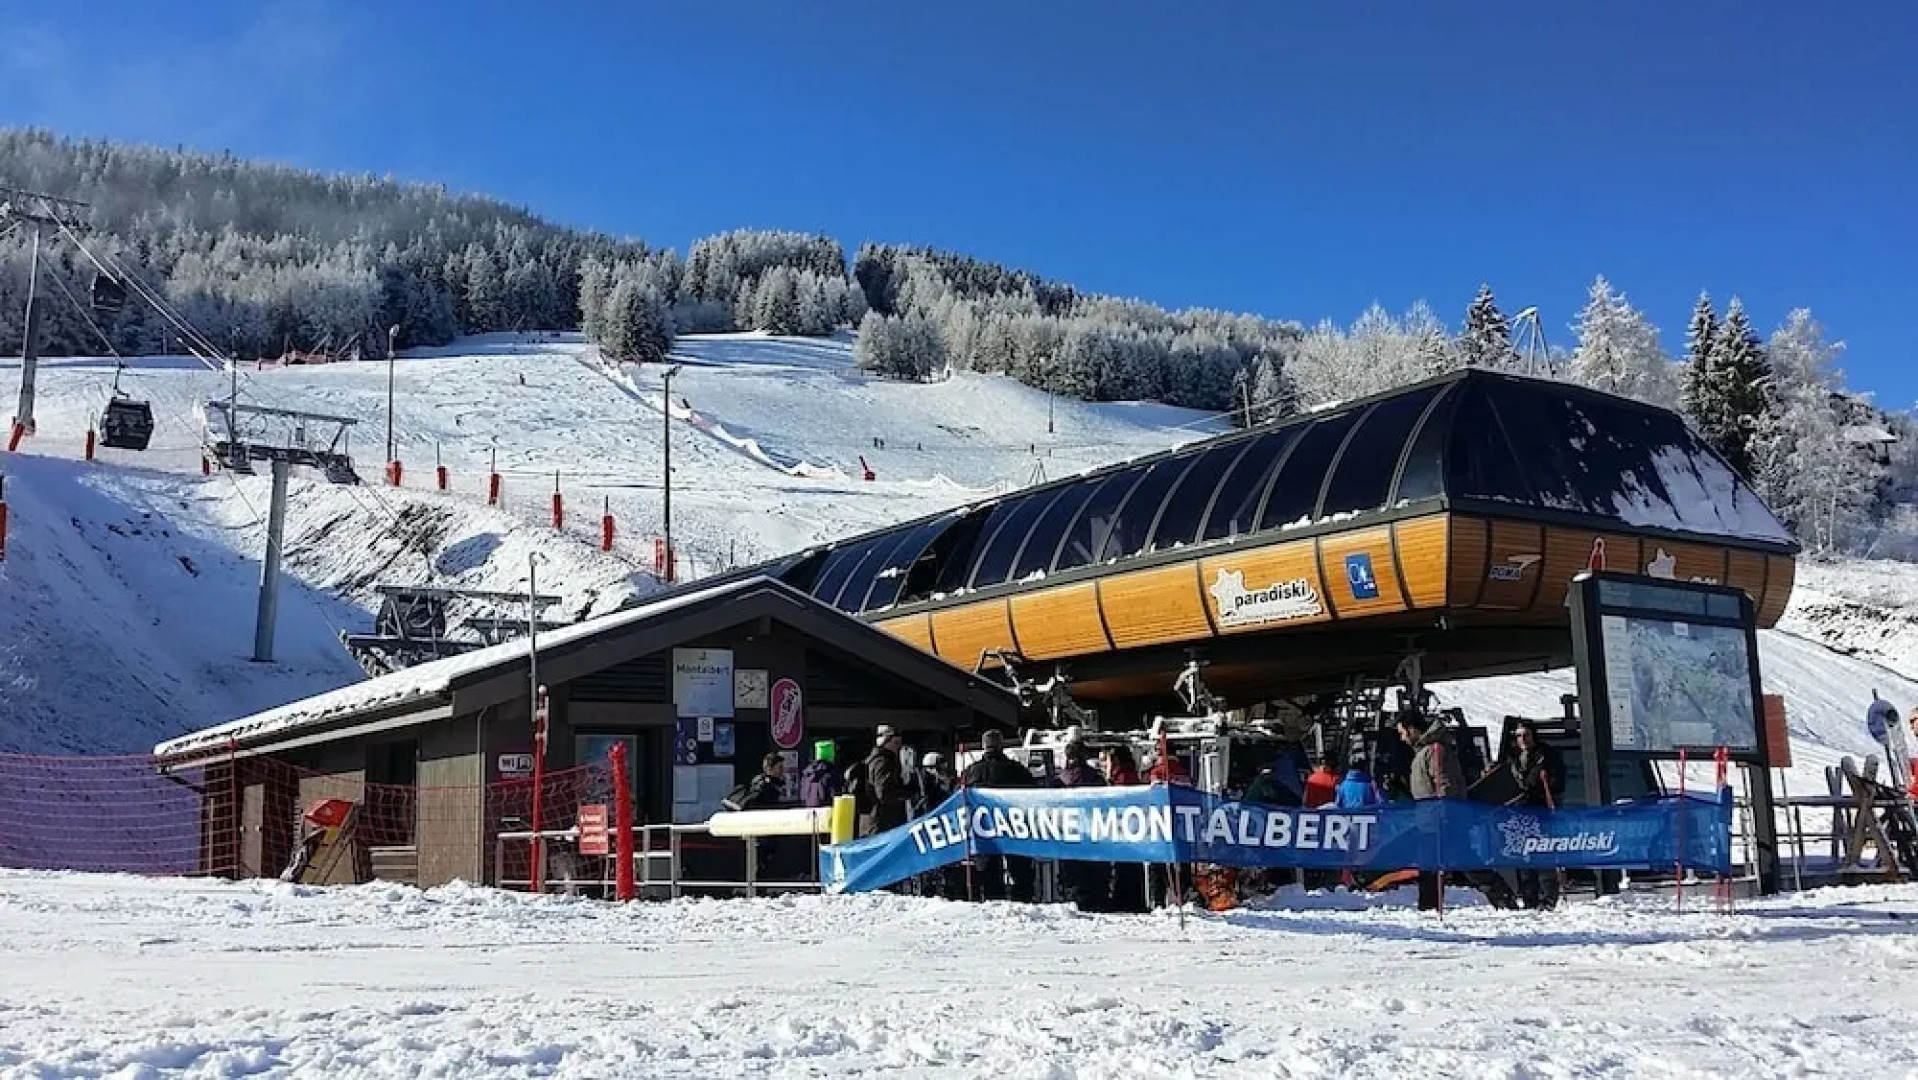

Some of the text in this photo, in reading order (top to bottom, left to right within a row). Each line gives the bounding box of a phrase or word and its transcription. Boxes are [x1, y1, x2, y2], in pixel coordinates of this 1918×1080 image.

[1234, 580, 1306, 610] paradiski
[1090, 804, 1377, 851] MONTALBERT
[1522, 831, 1616, 857] paradiski
